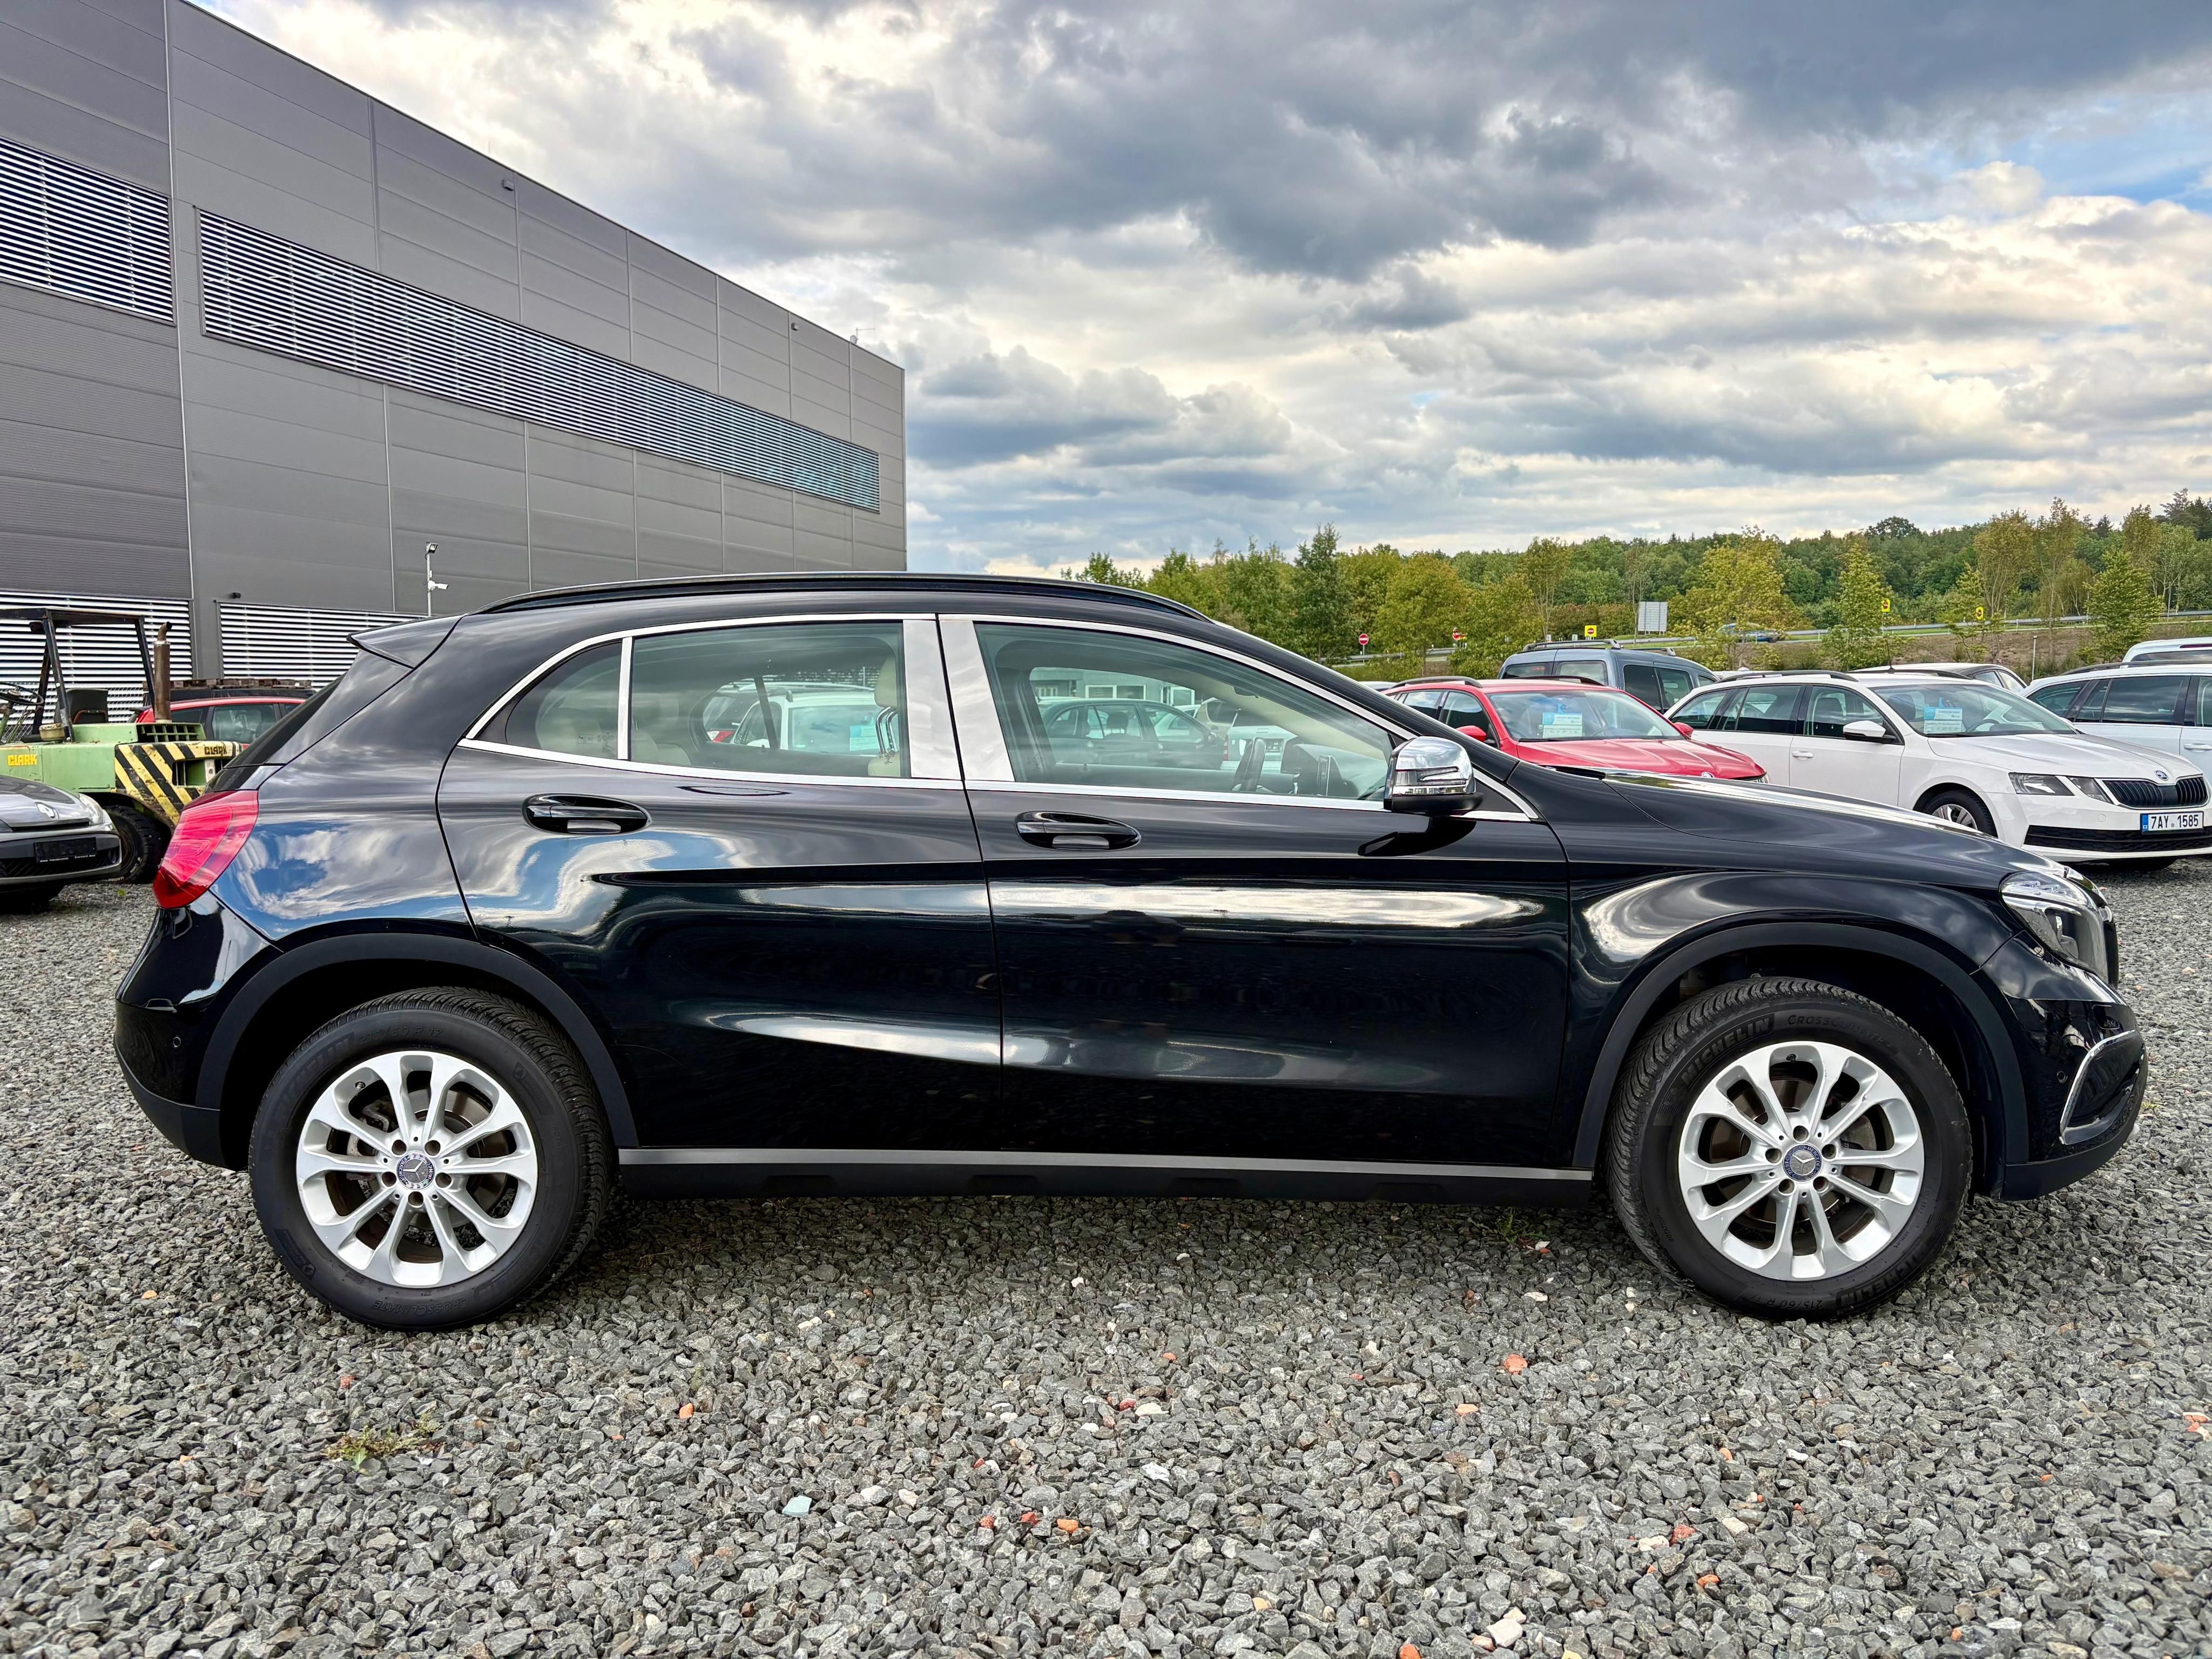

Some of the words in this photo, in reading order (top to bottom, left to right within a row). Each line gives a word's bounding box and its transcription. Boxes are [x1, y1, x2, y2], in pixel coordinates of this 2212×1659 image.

[8, 754, 37, 766] CLARK
[2151, 815, 2169, 829] 7AY
[2177, 814, 2198, 828] 1585
[428, 1027, 444, 1038] 17
[1681, 1017, 1770, 1085] MICHELIN
[1766, 1297, 1776, 1307] R
[1779, 1299, 1824, 1310] 215/60
